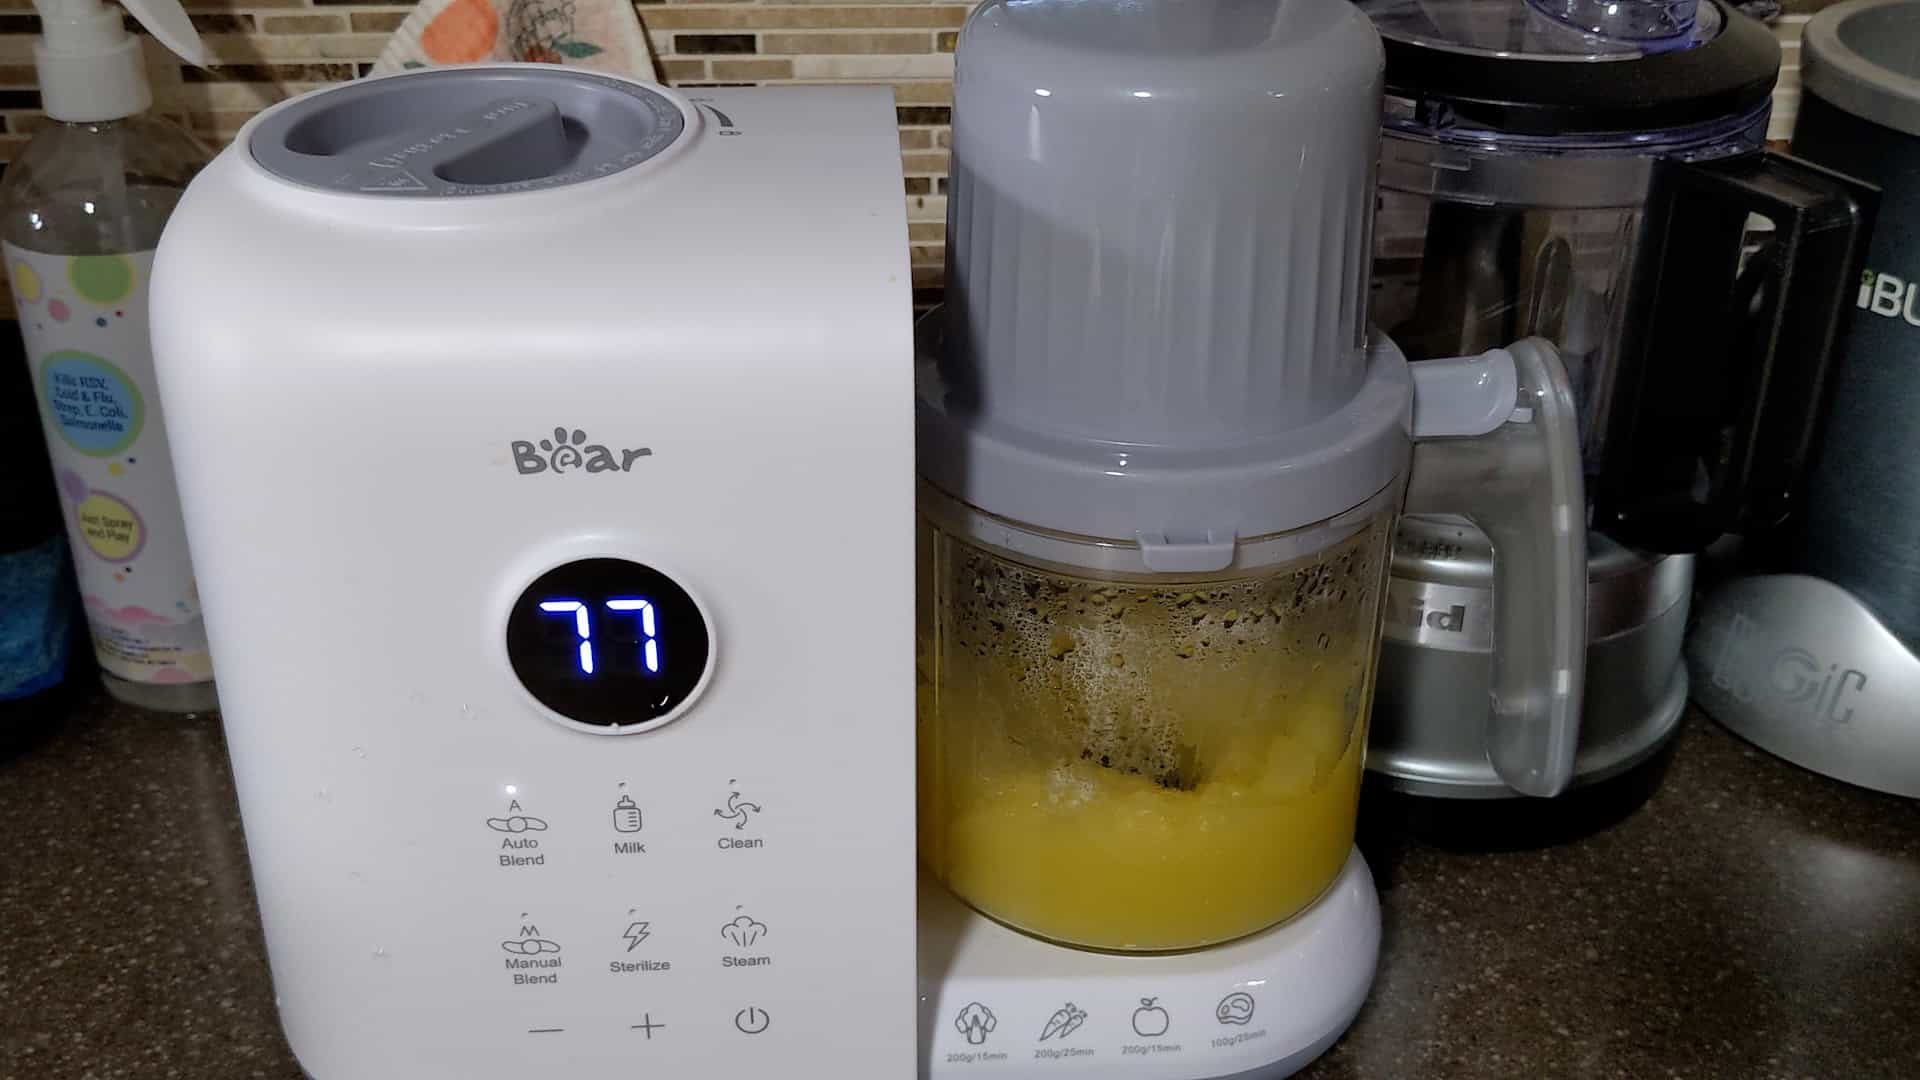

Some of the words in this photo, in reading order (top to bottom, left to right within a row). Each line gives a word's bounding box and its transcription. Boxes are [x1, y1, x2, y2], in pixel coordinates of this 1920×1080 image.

[539, 598, 659, 674] 77
[501, 837, 539, 850] Auto
[613, 841, 647, 854] Milk
[717, 837, 764, 849] Clean
[499, 854, 545, 867] Blend
[505, 956, 562, 970] Manual
[609, 960, 671, 973] Sterilize
[722, 955, 771, 968] Steam
[513, 973, 558, 985] Blend
[1034, 1047, 1095, 1060] 200g/25min
[1122, 1043, 1182, 1056] 200g/15min
[946, 1051, 1008, 1064] 200g/15min
